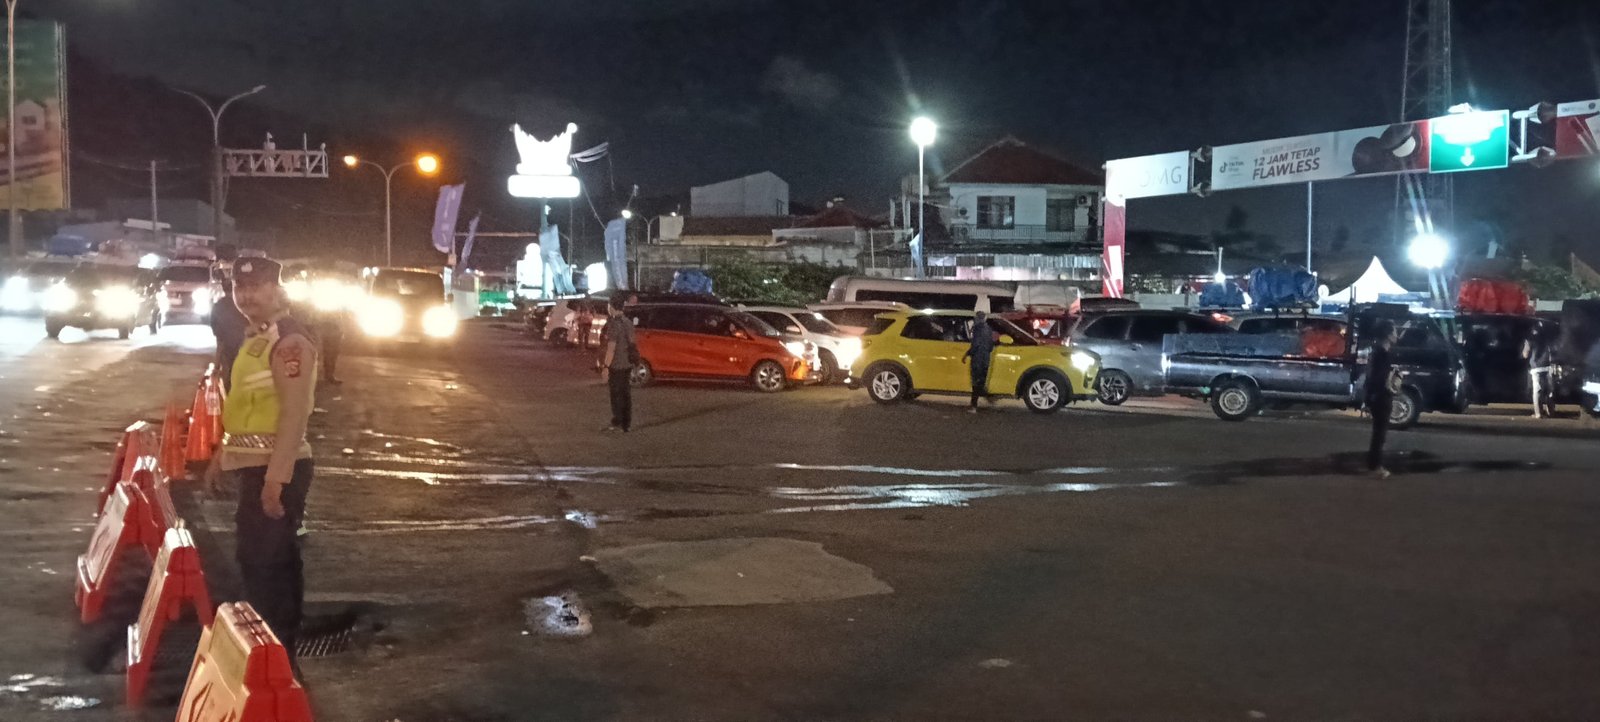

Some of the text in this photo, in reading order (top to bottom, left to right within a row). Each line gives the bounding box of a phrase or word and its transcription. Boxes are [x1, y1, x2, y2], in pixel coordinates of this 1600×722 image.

[1254, 157, 1265, 167] 12
[1267, 152, 1289, 165] JAM
[1291, 147, 1321, 160] TETAP
[1252, 157, 1320, 180] FLAWLESS
